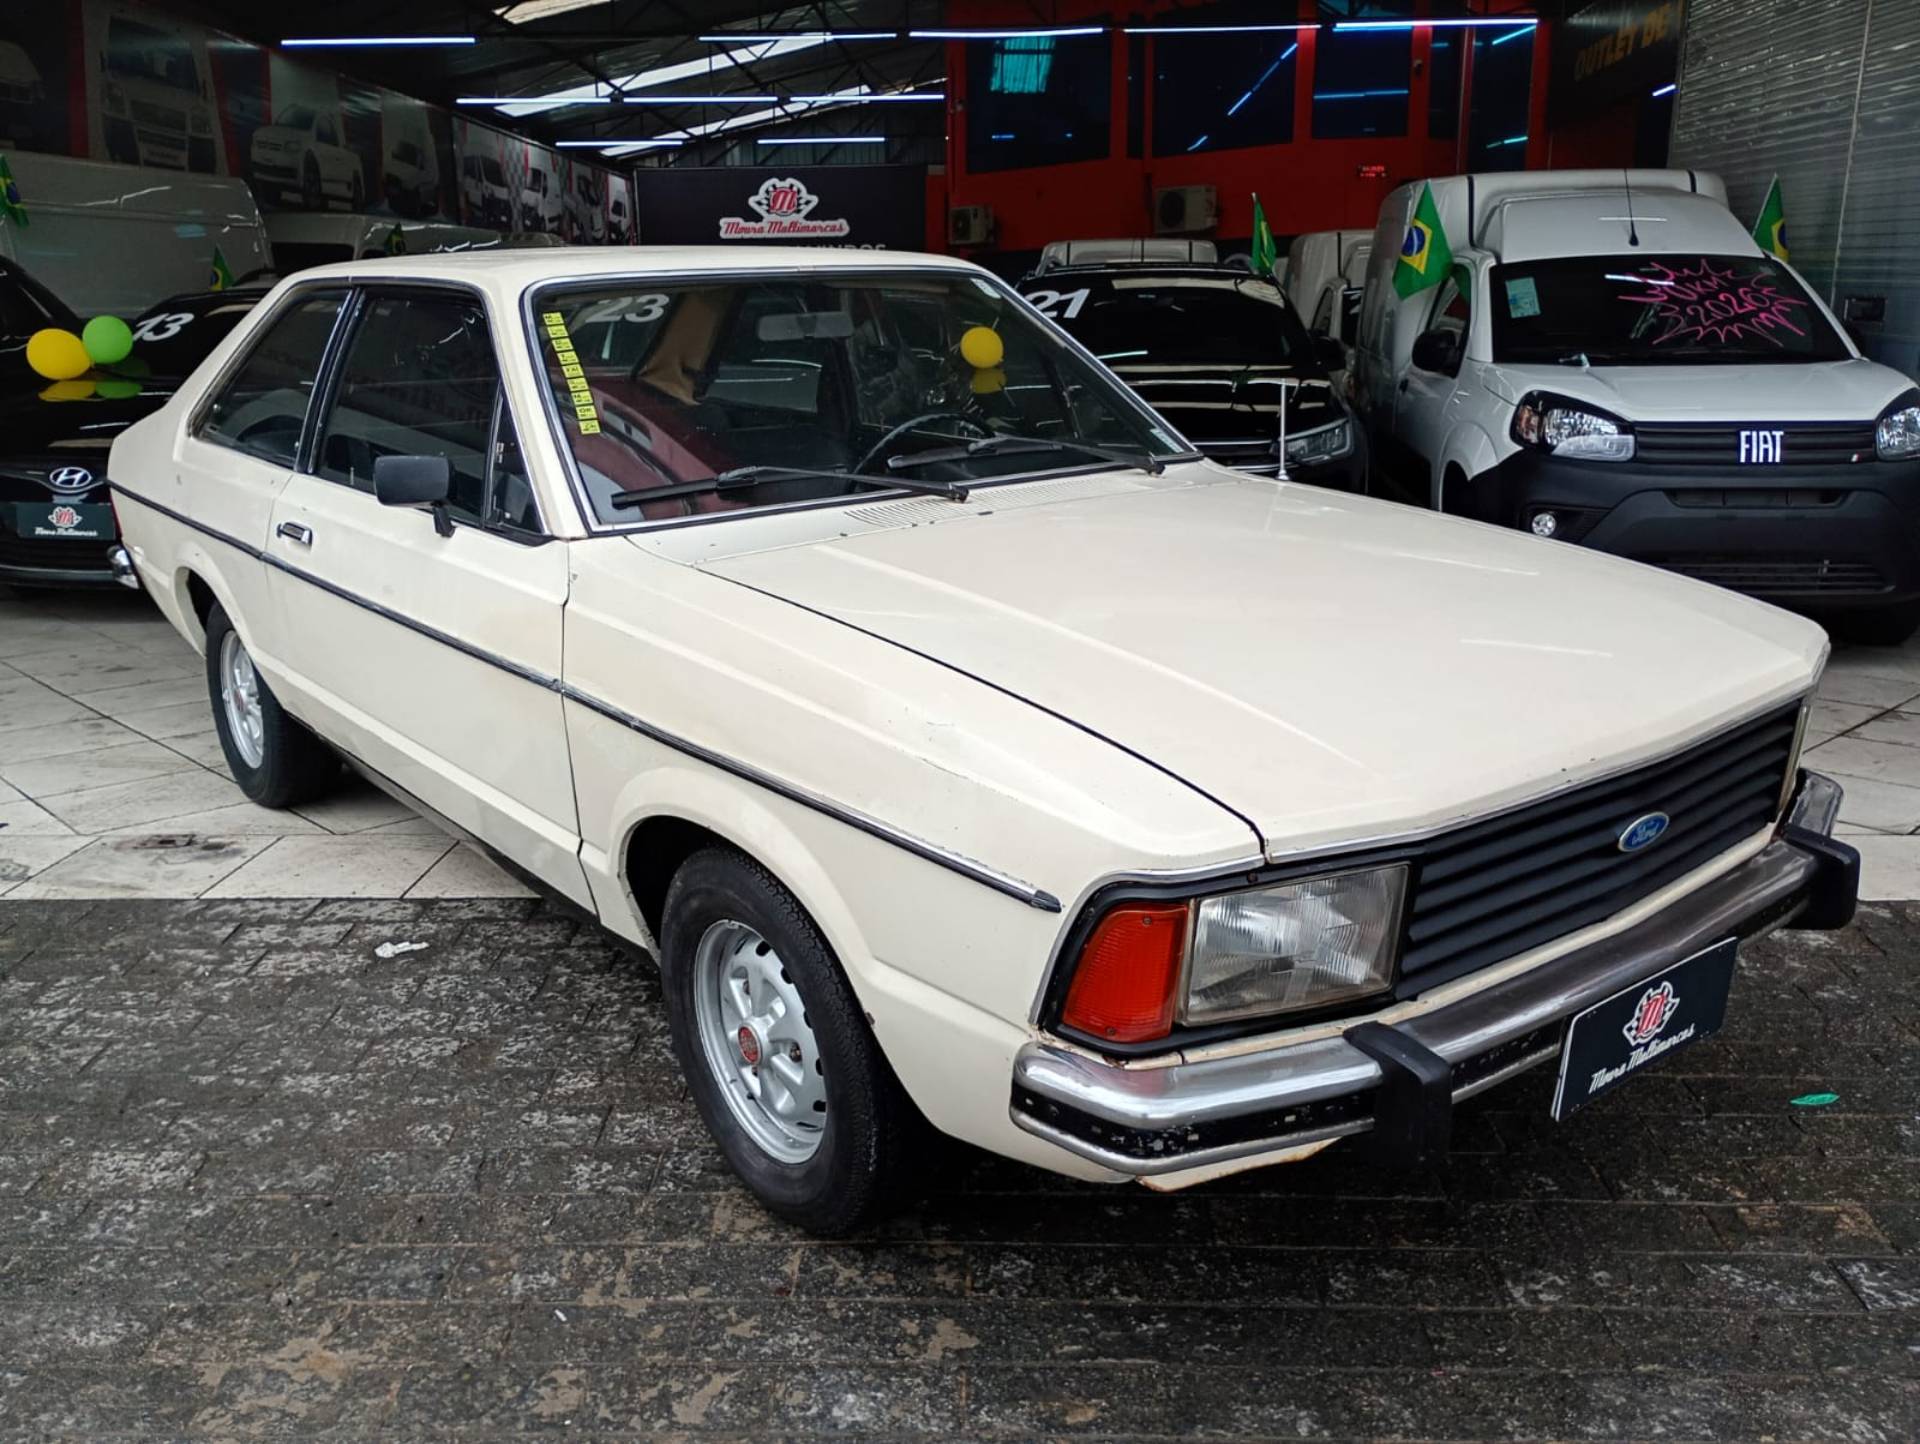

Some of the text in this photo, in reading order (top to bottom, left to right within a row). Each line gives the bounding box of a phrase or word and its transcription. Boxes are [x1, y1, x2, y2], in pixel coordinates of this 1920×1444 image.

[724, 221, 844, 235] Moura Multimarcas
[585, 294, 670, 323] 23
[1024, 288, 1090, 318] 21
[132, 312, 195, 342] 13
[1740, 430, 1784, 463] FIAT
